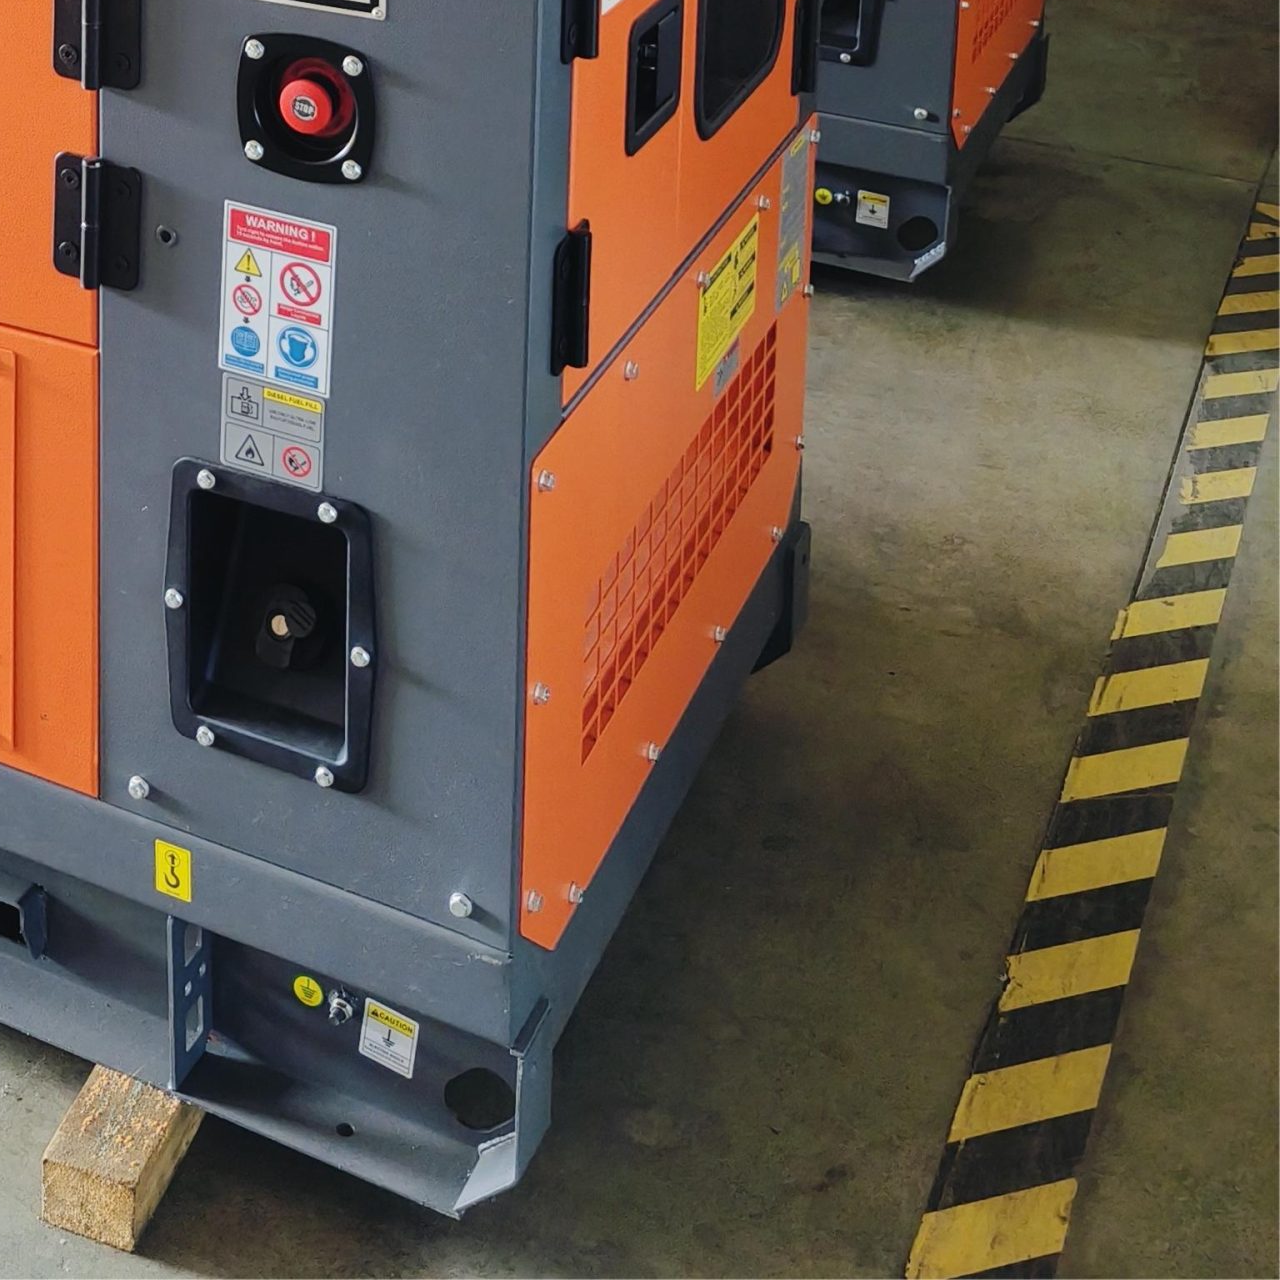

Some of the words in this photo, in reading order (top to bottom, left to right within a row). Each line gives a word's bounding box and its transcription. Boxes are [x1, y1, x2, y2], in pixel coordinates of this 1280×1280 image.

[295, 101, 314, 114] STOP
[245, 214, 308, 240] WARNING
[267, 390, 287, 402] DIESEL
[288, 395, 304, 406] FUEL
[379, 1011, 413, 1034] CAUTION
